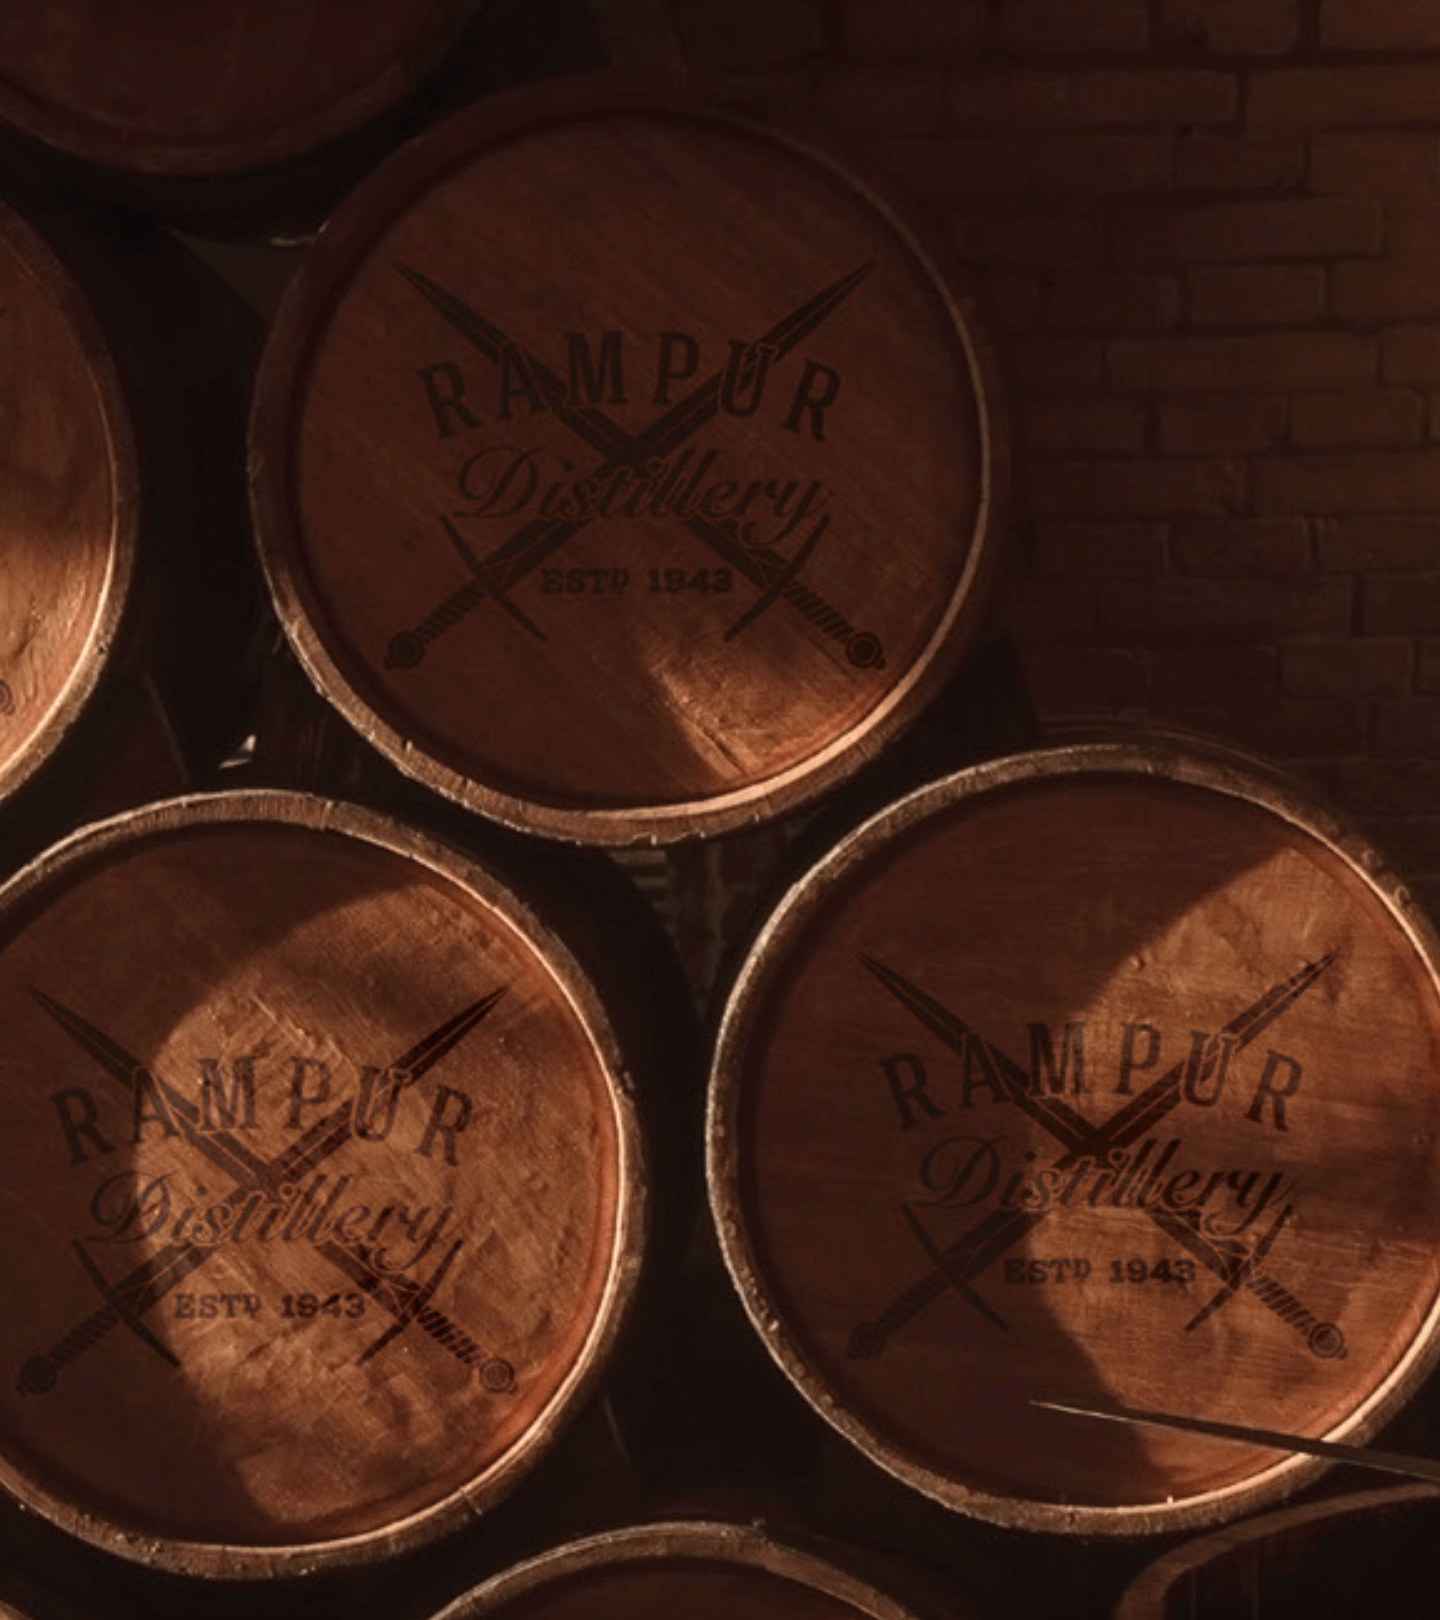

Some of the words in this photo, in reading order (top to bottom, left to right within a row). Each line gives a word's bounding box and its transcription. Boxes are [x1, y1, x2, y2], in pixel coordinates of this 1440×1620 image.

[416, 330, 842, 441] RAMPUR
[452, 446, 838, 548] Distillery
[648, 568, 735, 594] 1943
[48, 1055, 474, 1166] RAMPUR
[879, 1020, 1305, 1131] RAMPUR
[85, 1171, 470, 1273] Distillery
[915, 1136, 1300, 1238] Distillery
[281, 1294, 367, 1320] 1943
[1111, 1259, 1198, 1285] 1943
